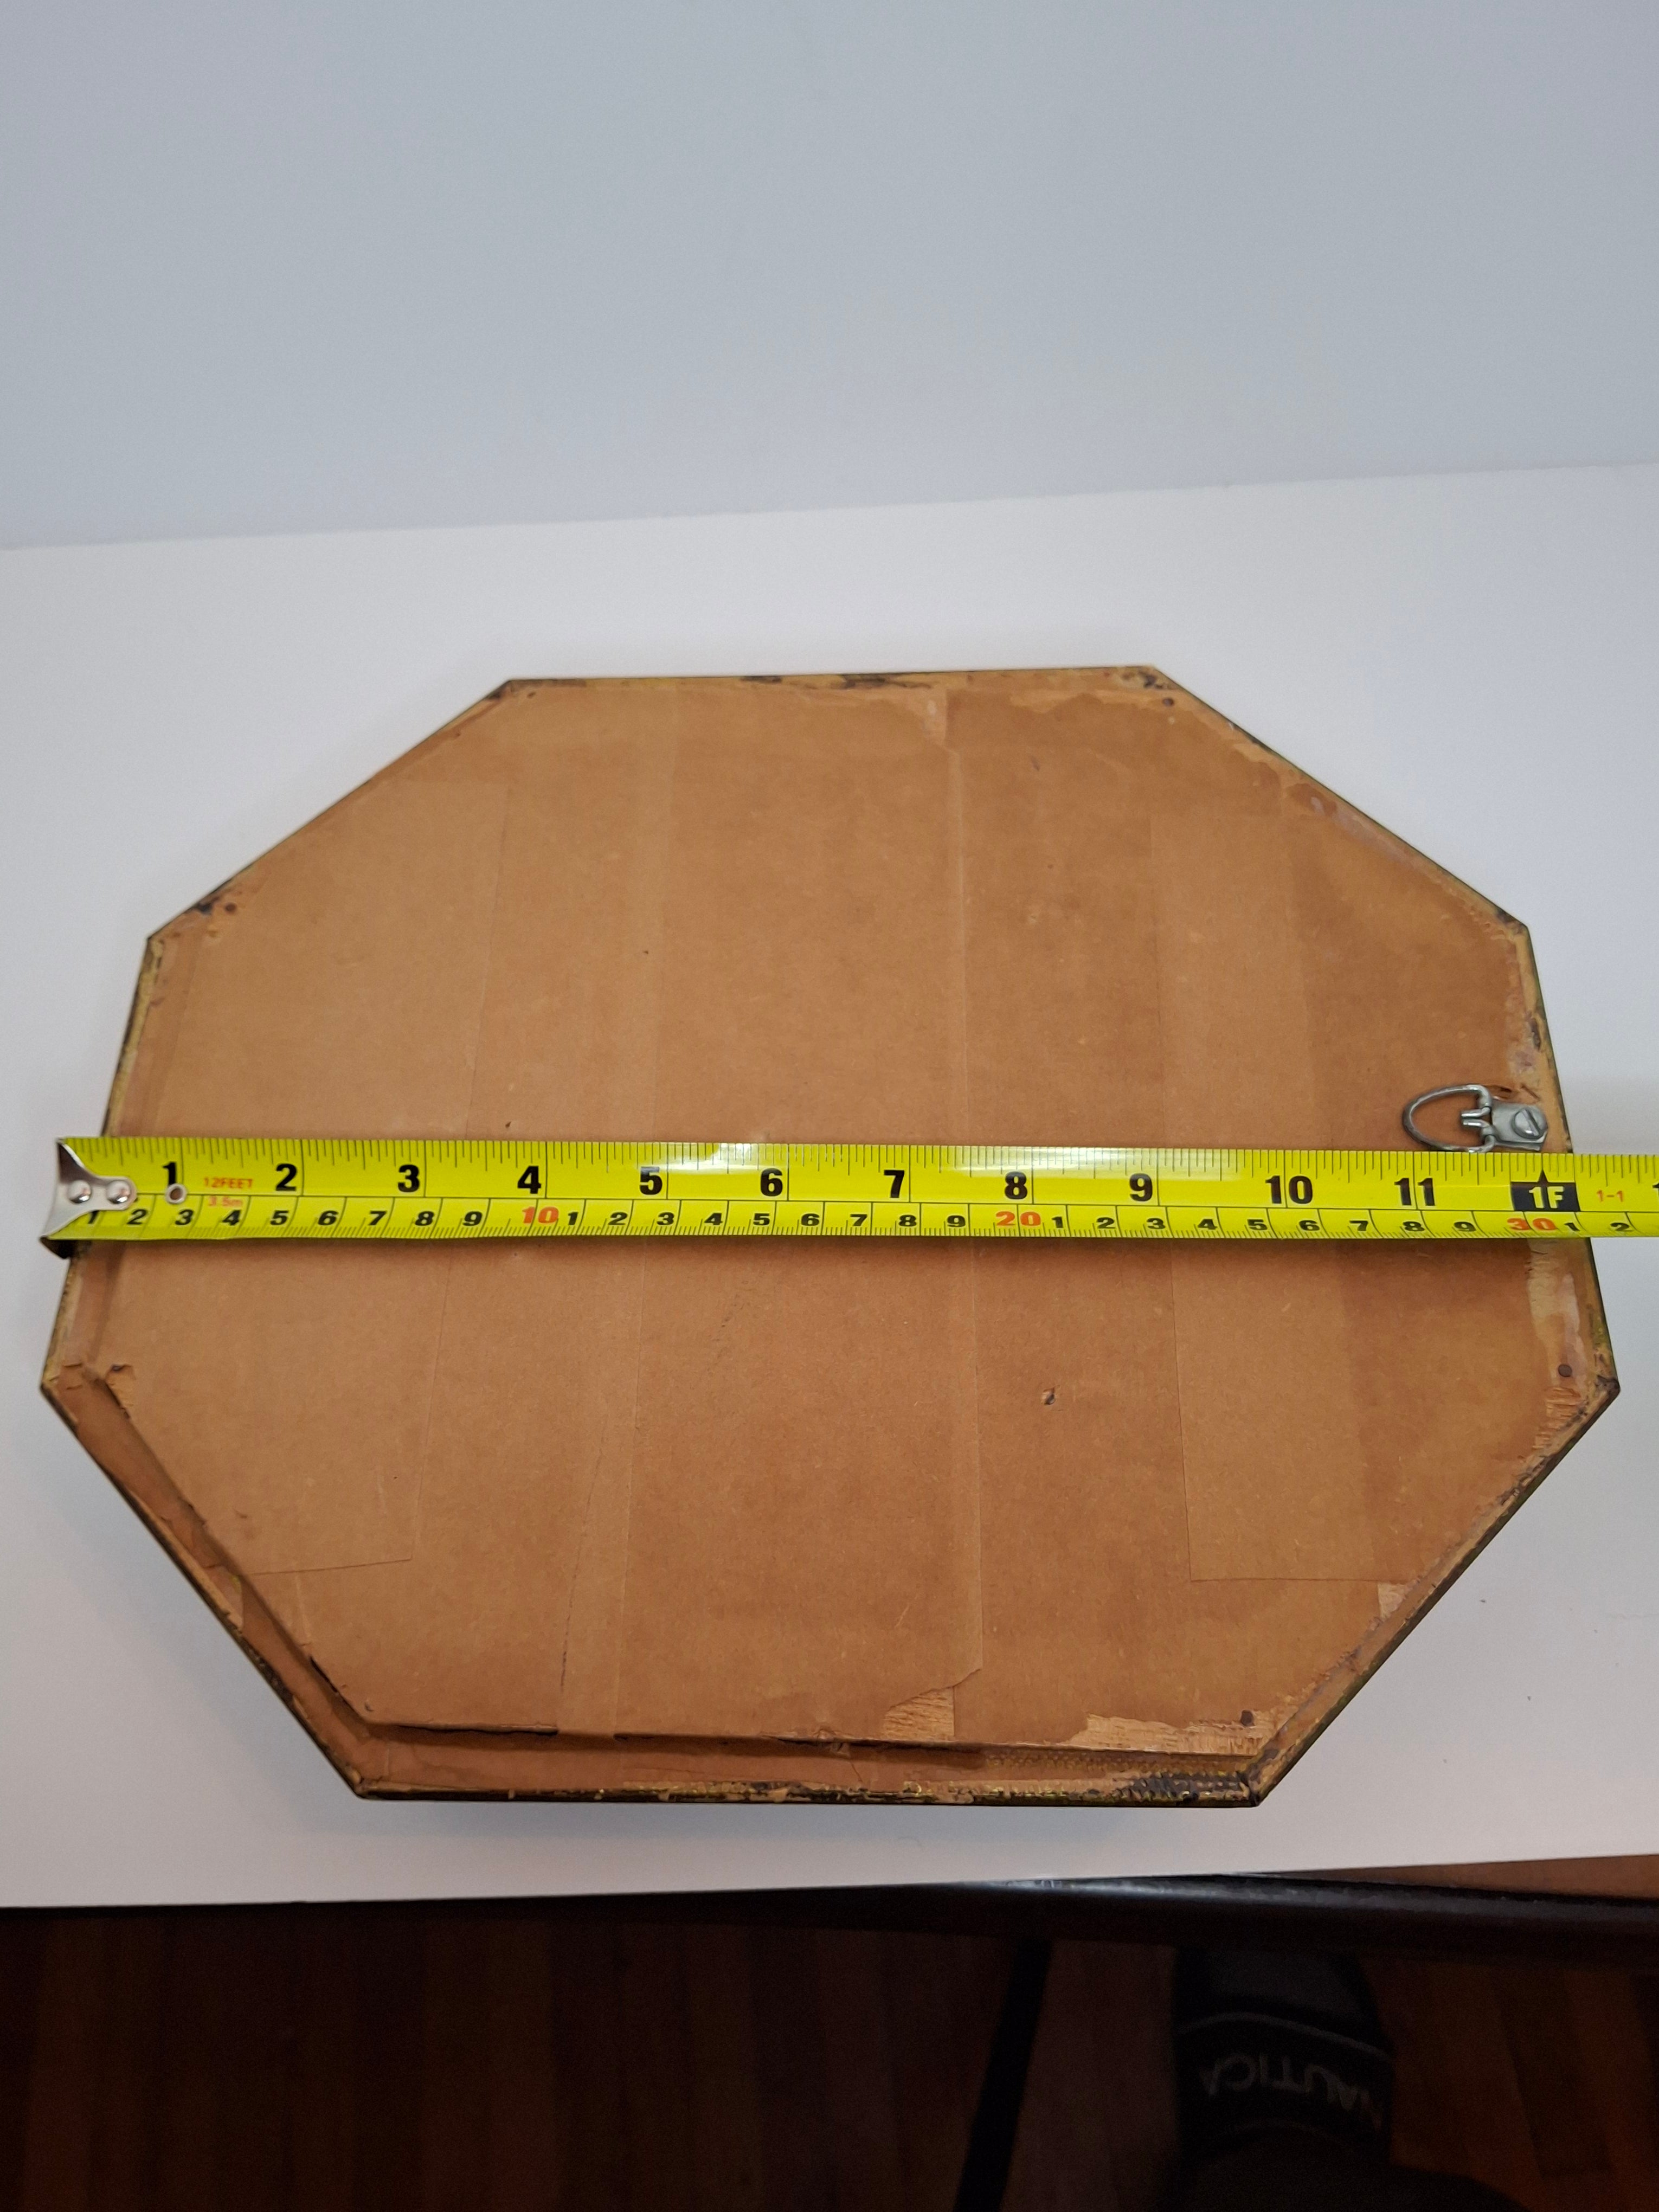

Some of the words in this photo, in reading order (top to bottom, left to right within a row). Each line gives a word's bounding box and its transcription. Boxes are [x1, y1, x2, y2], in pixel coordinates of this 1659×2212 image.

[163, 1161, 178, 1185] 1
[275, 1163, 298, 1192] 2
[397, 1165, 420, 1193] 3
[517, 1166, 542, 1194] 4
[639, 1166, 663, 1195] 5
[760, 1168, 783, 1197] 6
[883, 1169, 905, 1198] 7
[1005, 1172, 1028, 1200] 8
[1129, 1173, 1153, 1201] 9
[1265, 1175, 1313, 1204] 10
[1394, 1178, 1436, 1206] 11
[1528, 1186, 1565, 1208] 1F
[126, 1209, 148, 1225] 2
[175, 1210, 194, 1226] 3
[222, 1210, 242, 1226] 4
[270, 1211, 288, 1226] 5
[318, 1211, 338, 1226] 6
[368, 1211, 387, 1226] 7
[414, 1211, 434, 1226] 8
[462, 1211, 483, 1226] 9
[522, 1207, 559, 1224] 10
[568, 1212, 578, 1225] 1
[608, 1212, 628, 1225] 2
[657, 1212, 674, 1226] 3
[704, 1213, 723, 1226] 4
[753, 1213, 770, 1226] 5
[800, 1213, 820, 1226] 6
[850, 1214, 868, 1226] 7
[898, 1214, 917, 1227] 8
[947, 1215, 966, 1227] 9
[995, 1211, 1041, 1226] 20
[1052, 1217, 1064, 1229] 1
[1097, 1217, 1116, 1229] 2
[1147, 1218, 1166, 1230] 3
[1198, 1218, 1218, 1230] 4
[1247, 1219, 1268, 1231] 5
[1298, 1220, 1320, 1231] 6
[1349, 1220, 1368, 1232] 7
[1403, 1221, 1425, 1232] 8
[1454, 1221, 1476, 1232] 9
[1507, 1218, 1556, 1231] 30
[1564, 1222, 1580, 1232] 1
[1610, 1222, 1633, 1232] 2
